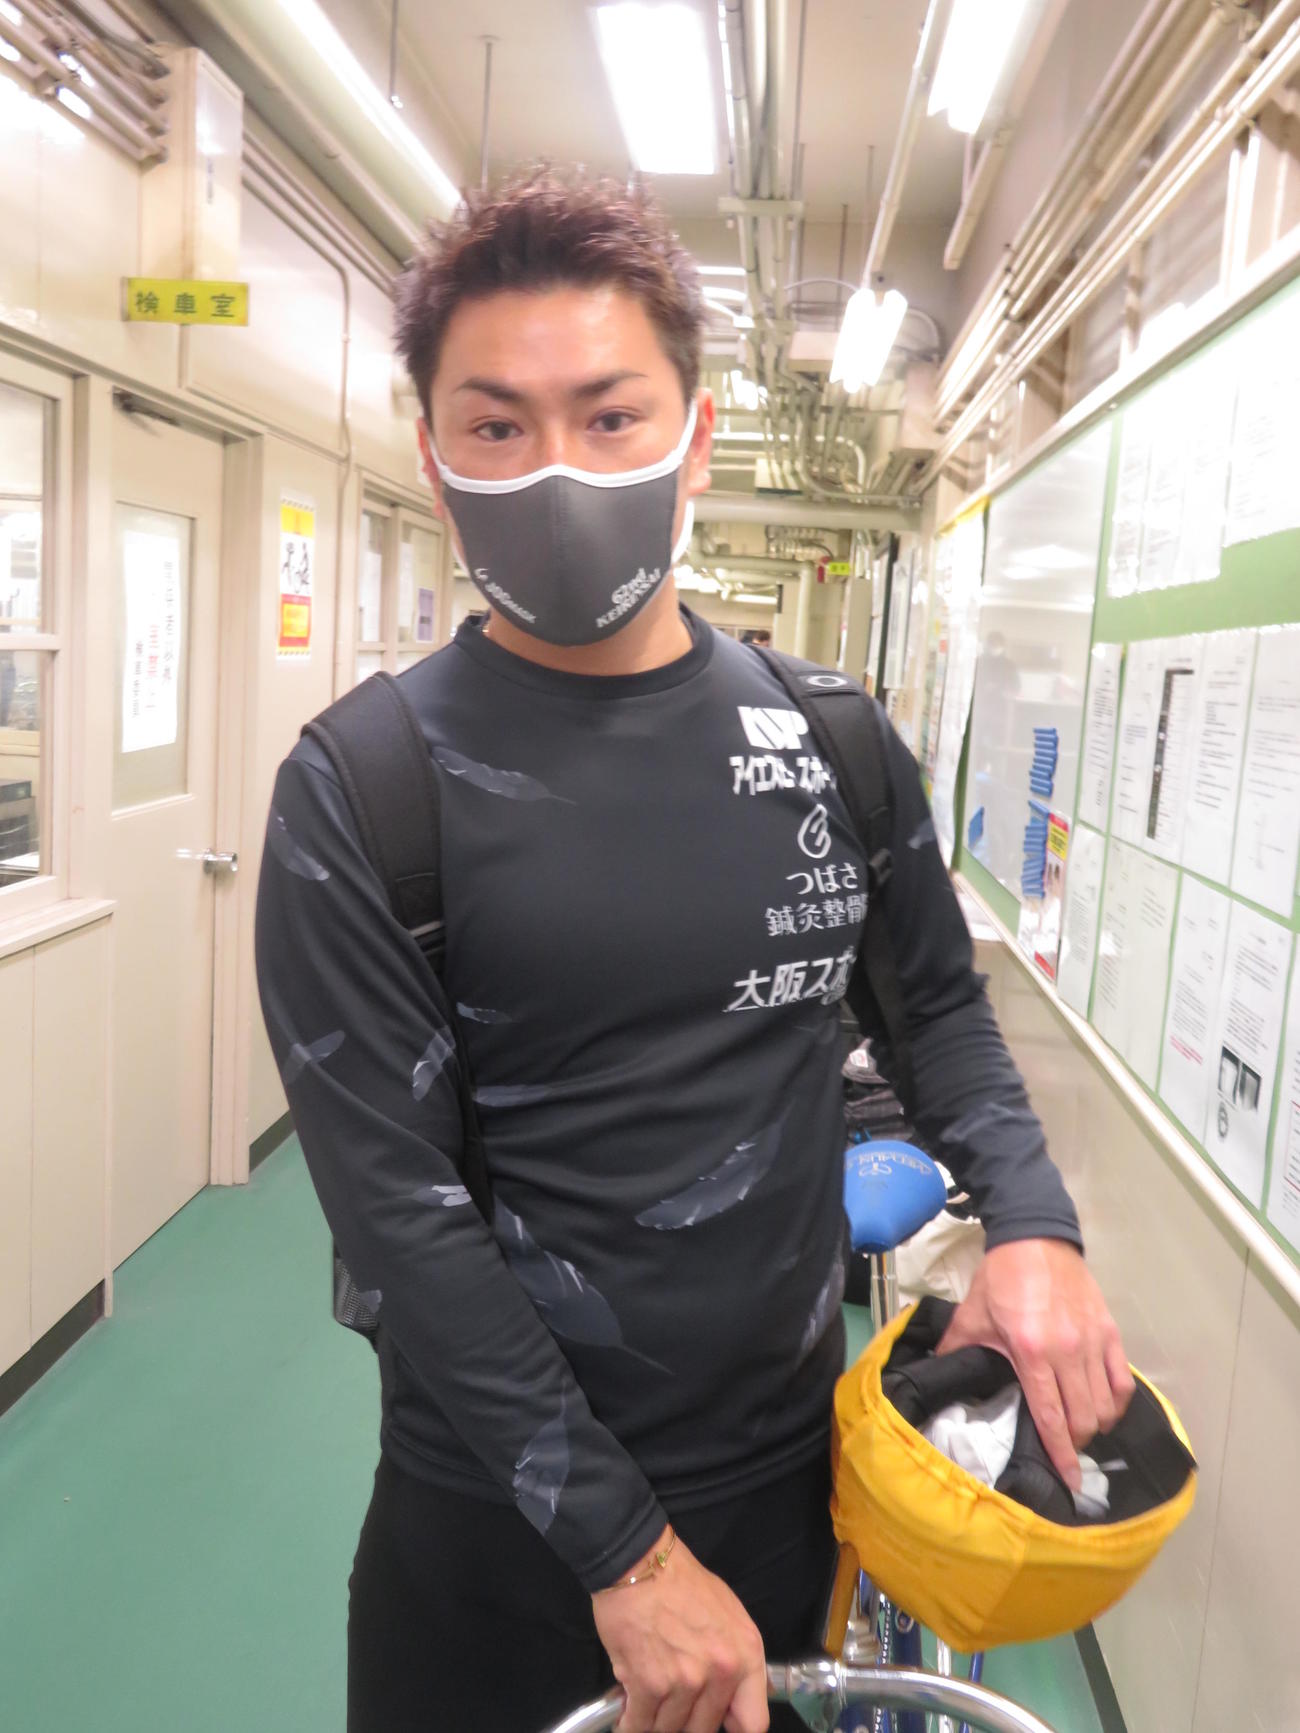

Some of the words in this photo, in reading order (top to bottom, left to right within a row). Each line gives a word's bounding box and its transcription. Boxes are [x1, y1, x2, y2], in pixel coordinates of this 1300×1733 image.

[134, 290, 236, 319] 検車室
[785, 862, 858, 895] つばさ
[764, 893, 868, 937] 鍼灸整骨
